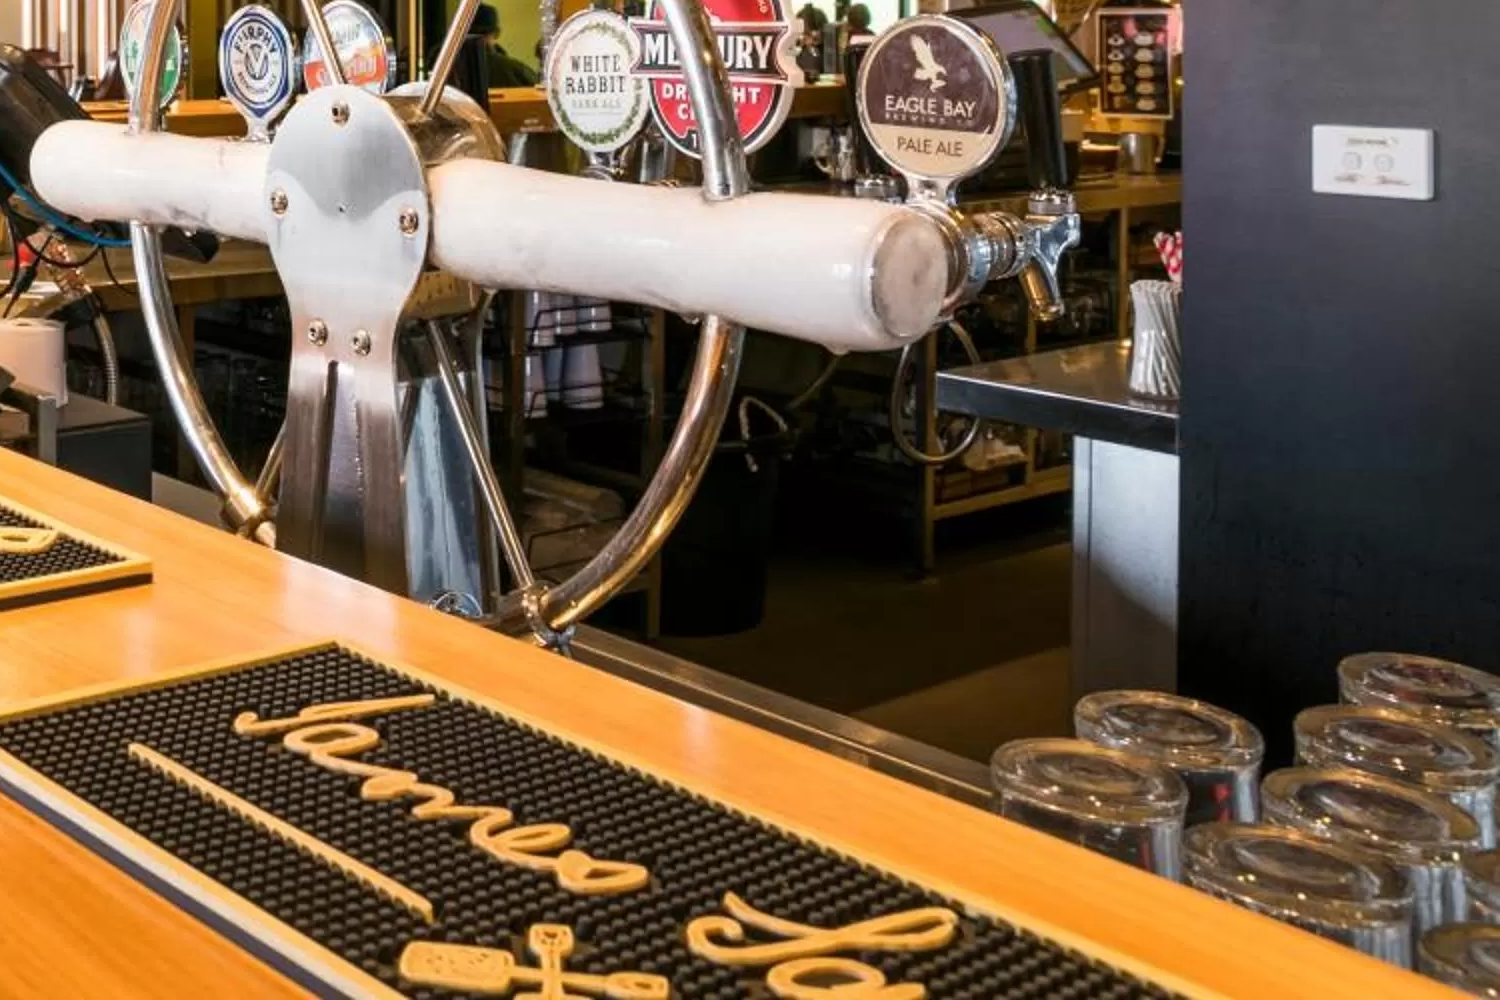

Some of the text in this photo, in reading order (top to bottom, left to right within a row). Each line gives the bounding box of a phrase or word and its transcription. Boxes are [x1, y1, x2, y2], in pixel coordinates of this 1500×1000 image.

[644, 32, 773, 70] MEURY
[570, 53, 621, 73] WHITE
[565, 74, 626, 95] RABBIT
[662, 82, 761, 105] DRHT
[885, 94, 977, 118] EAGLE BAY
[896, 136, 964, 157] PALE ALE
[231, 692, 651, 897] James
